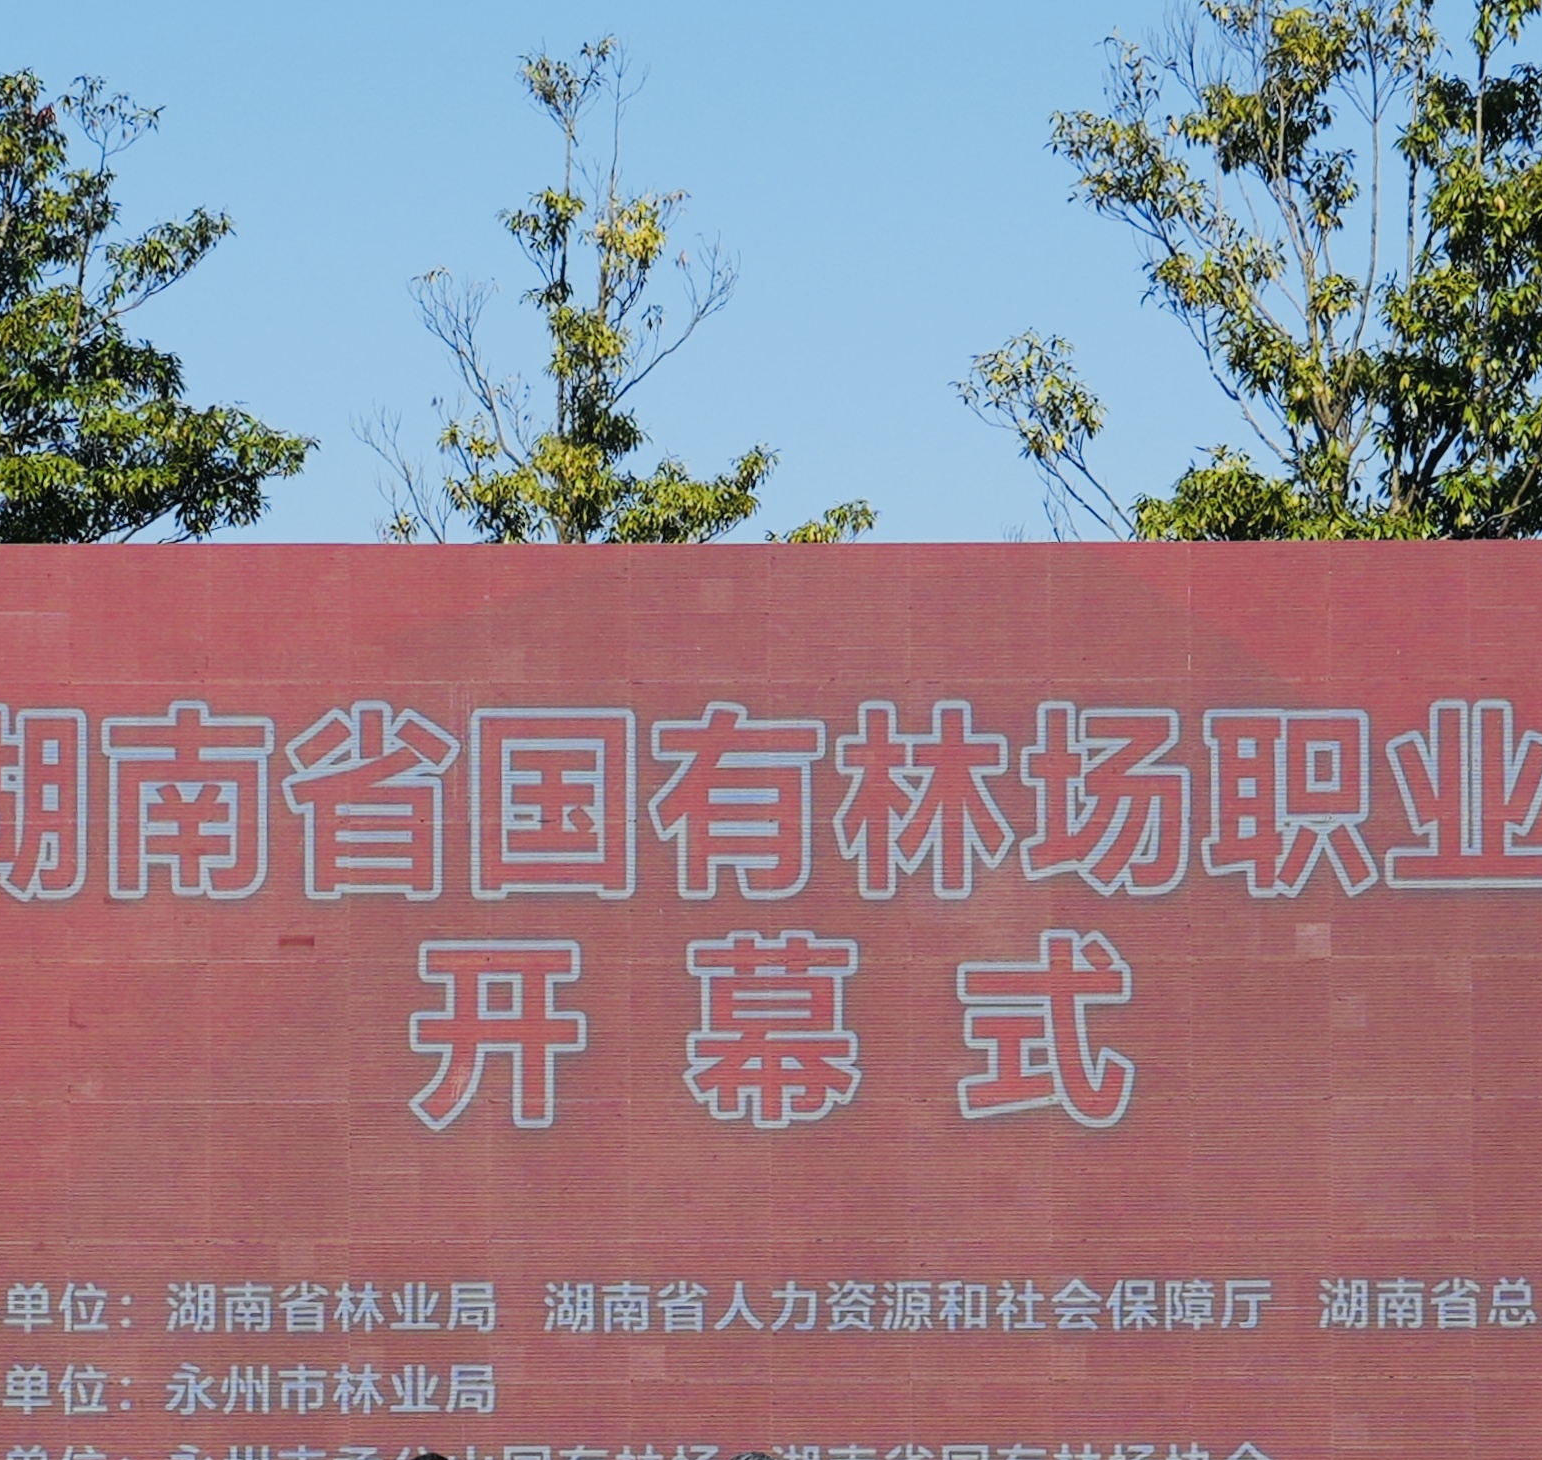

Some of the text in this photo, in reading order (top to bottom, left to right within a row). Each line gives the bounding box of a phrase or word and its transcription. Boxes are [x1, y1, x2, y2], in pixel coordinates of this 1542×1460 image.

[543, 1277, 1274, 1332] 湖南省人力资源和社会保障厅
